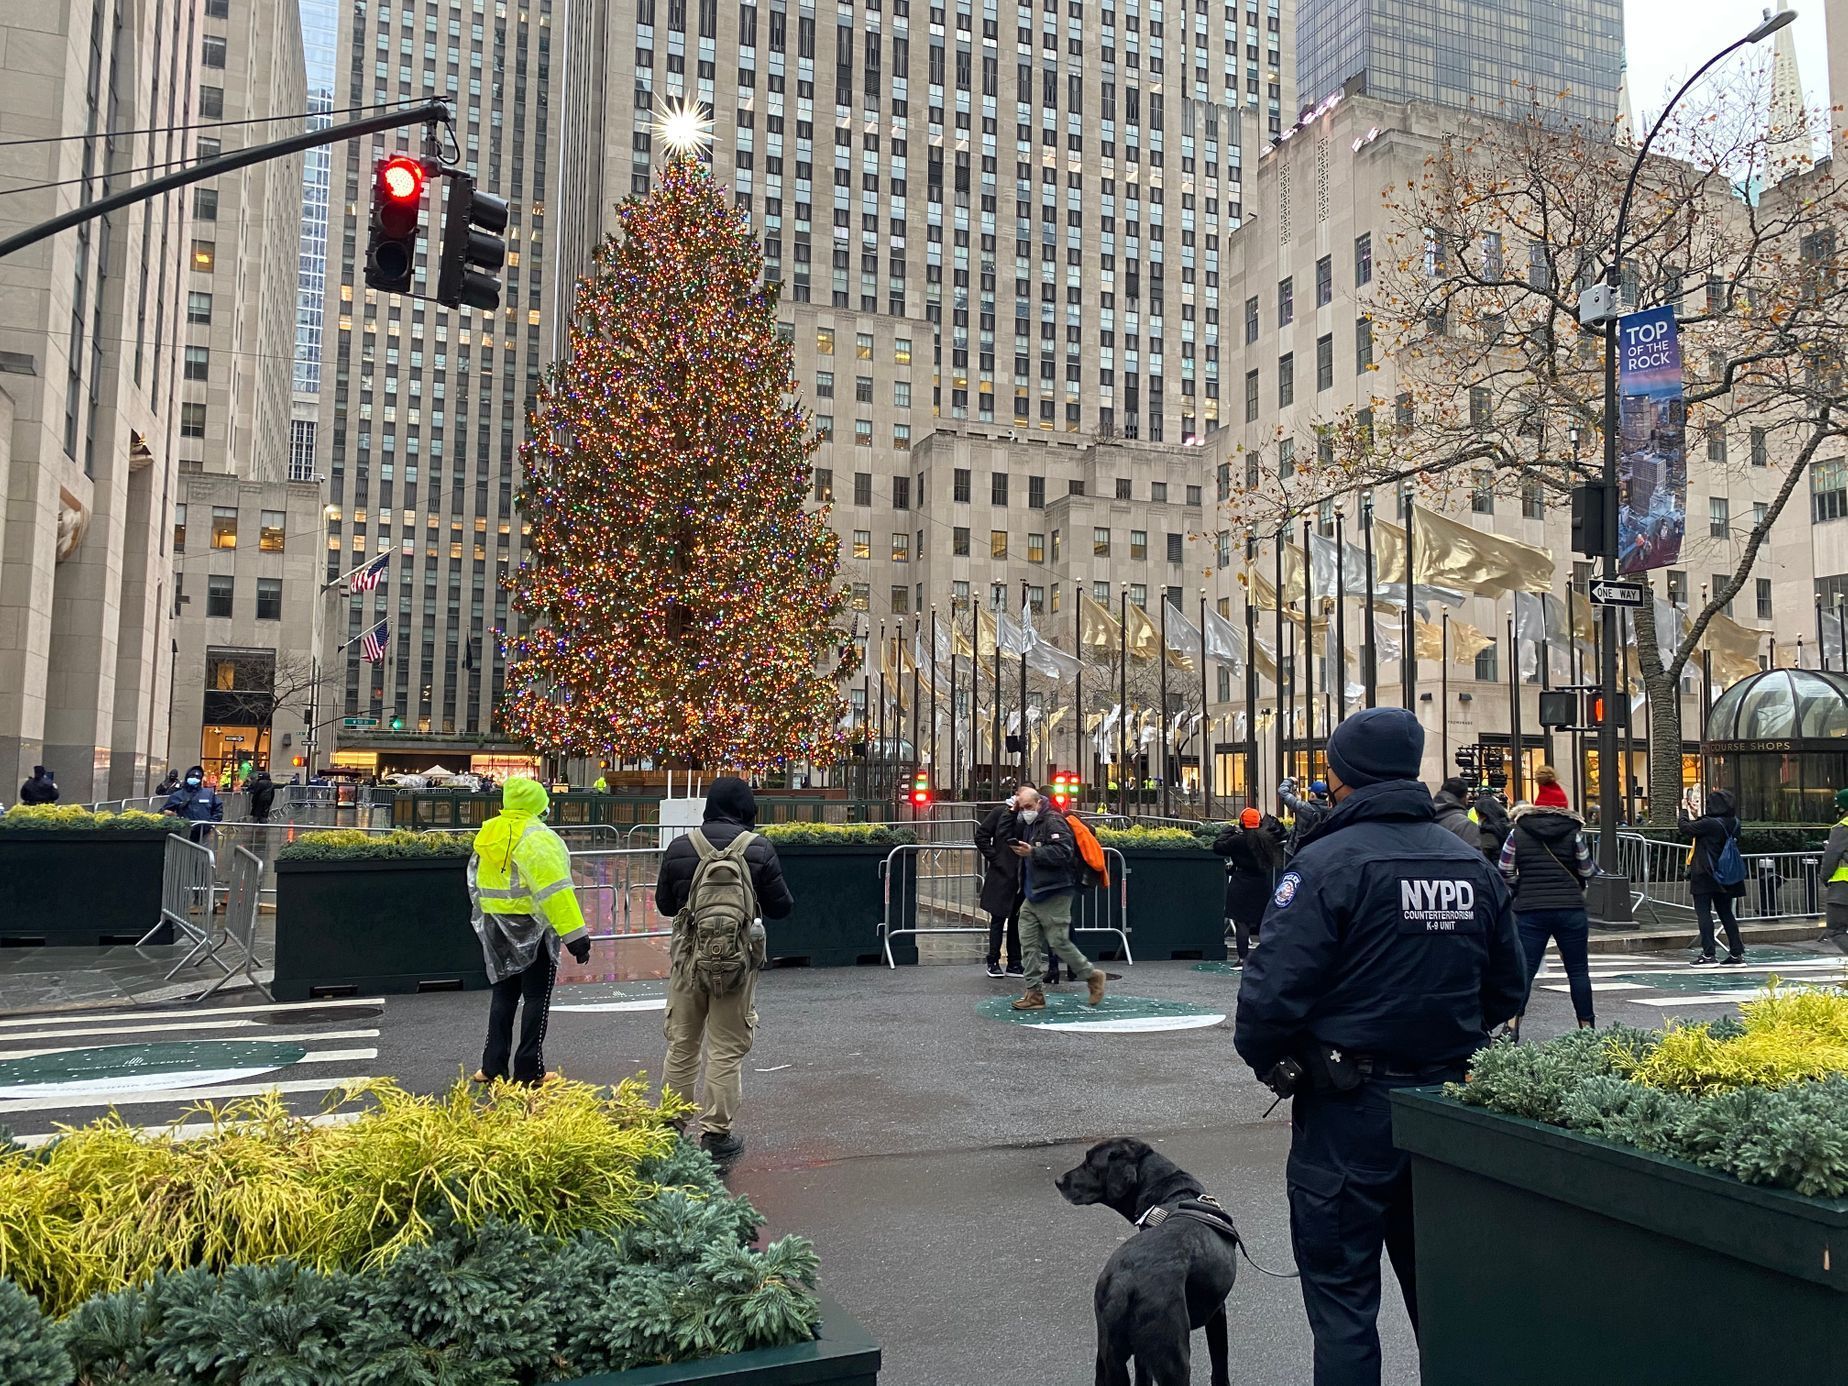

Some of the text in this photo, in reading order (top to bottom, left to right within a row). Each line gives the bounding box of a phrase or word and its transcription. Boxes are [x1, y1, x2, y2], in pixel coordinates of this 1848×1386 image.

[1626, 321, 1668, 345] TOP
[1628, 340, 1669, 357] OF THE
[1628, 351, 1670, 371] ROCK
[1597, 587, 1636, 600] ONE WAY
[1750, 741, 1791, 751] SHOPS
[1400, 880, 1475, 911] NYPD
[1403, 911, 1475, 920] COUNTERTERRORISM
[1426, 921, 1456, 931] K-9 UNIT
